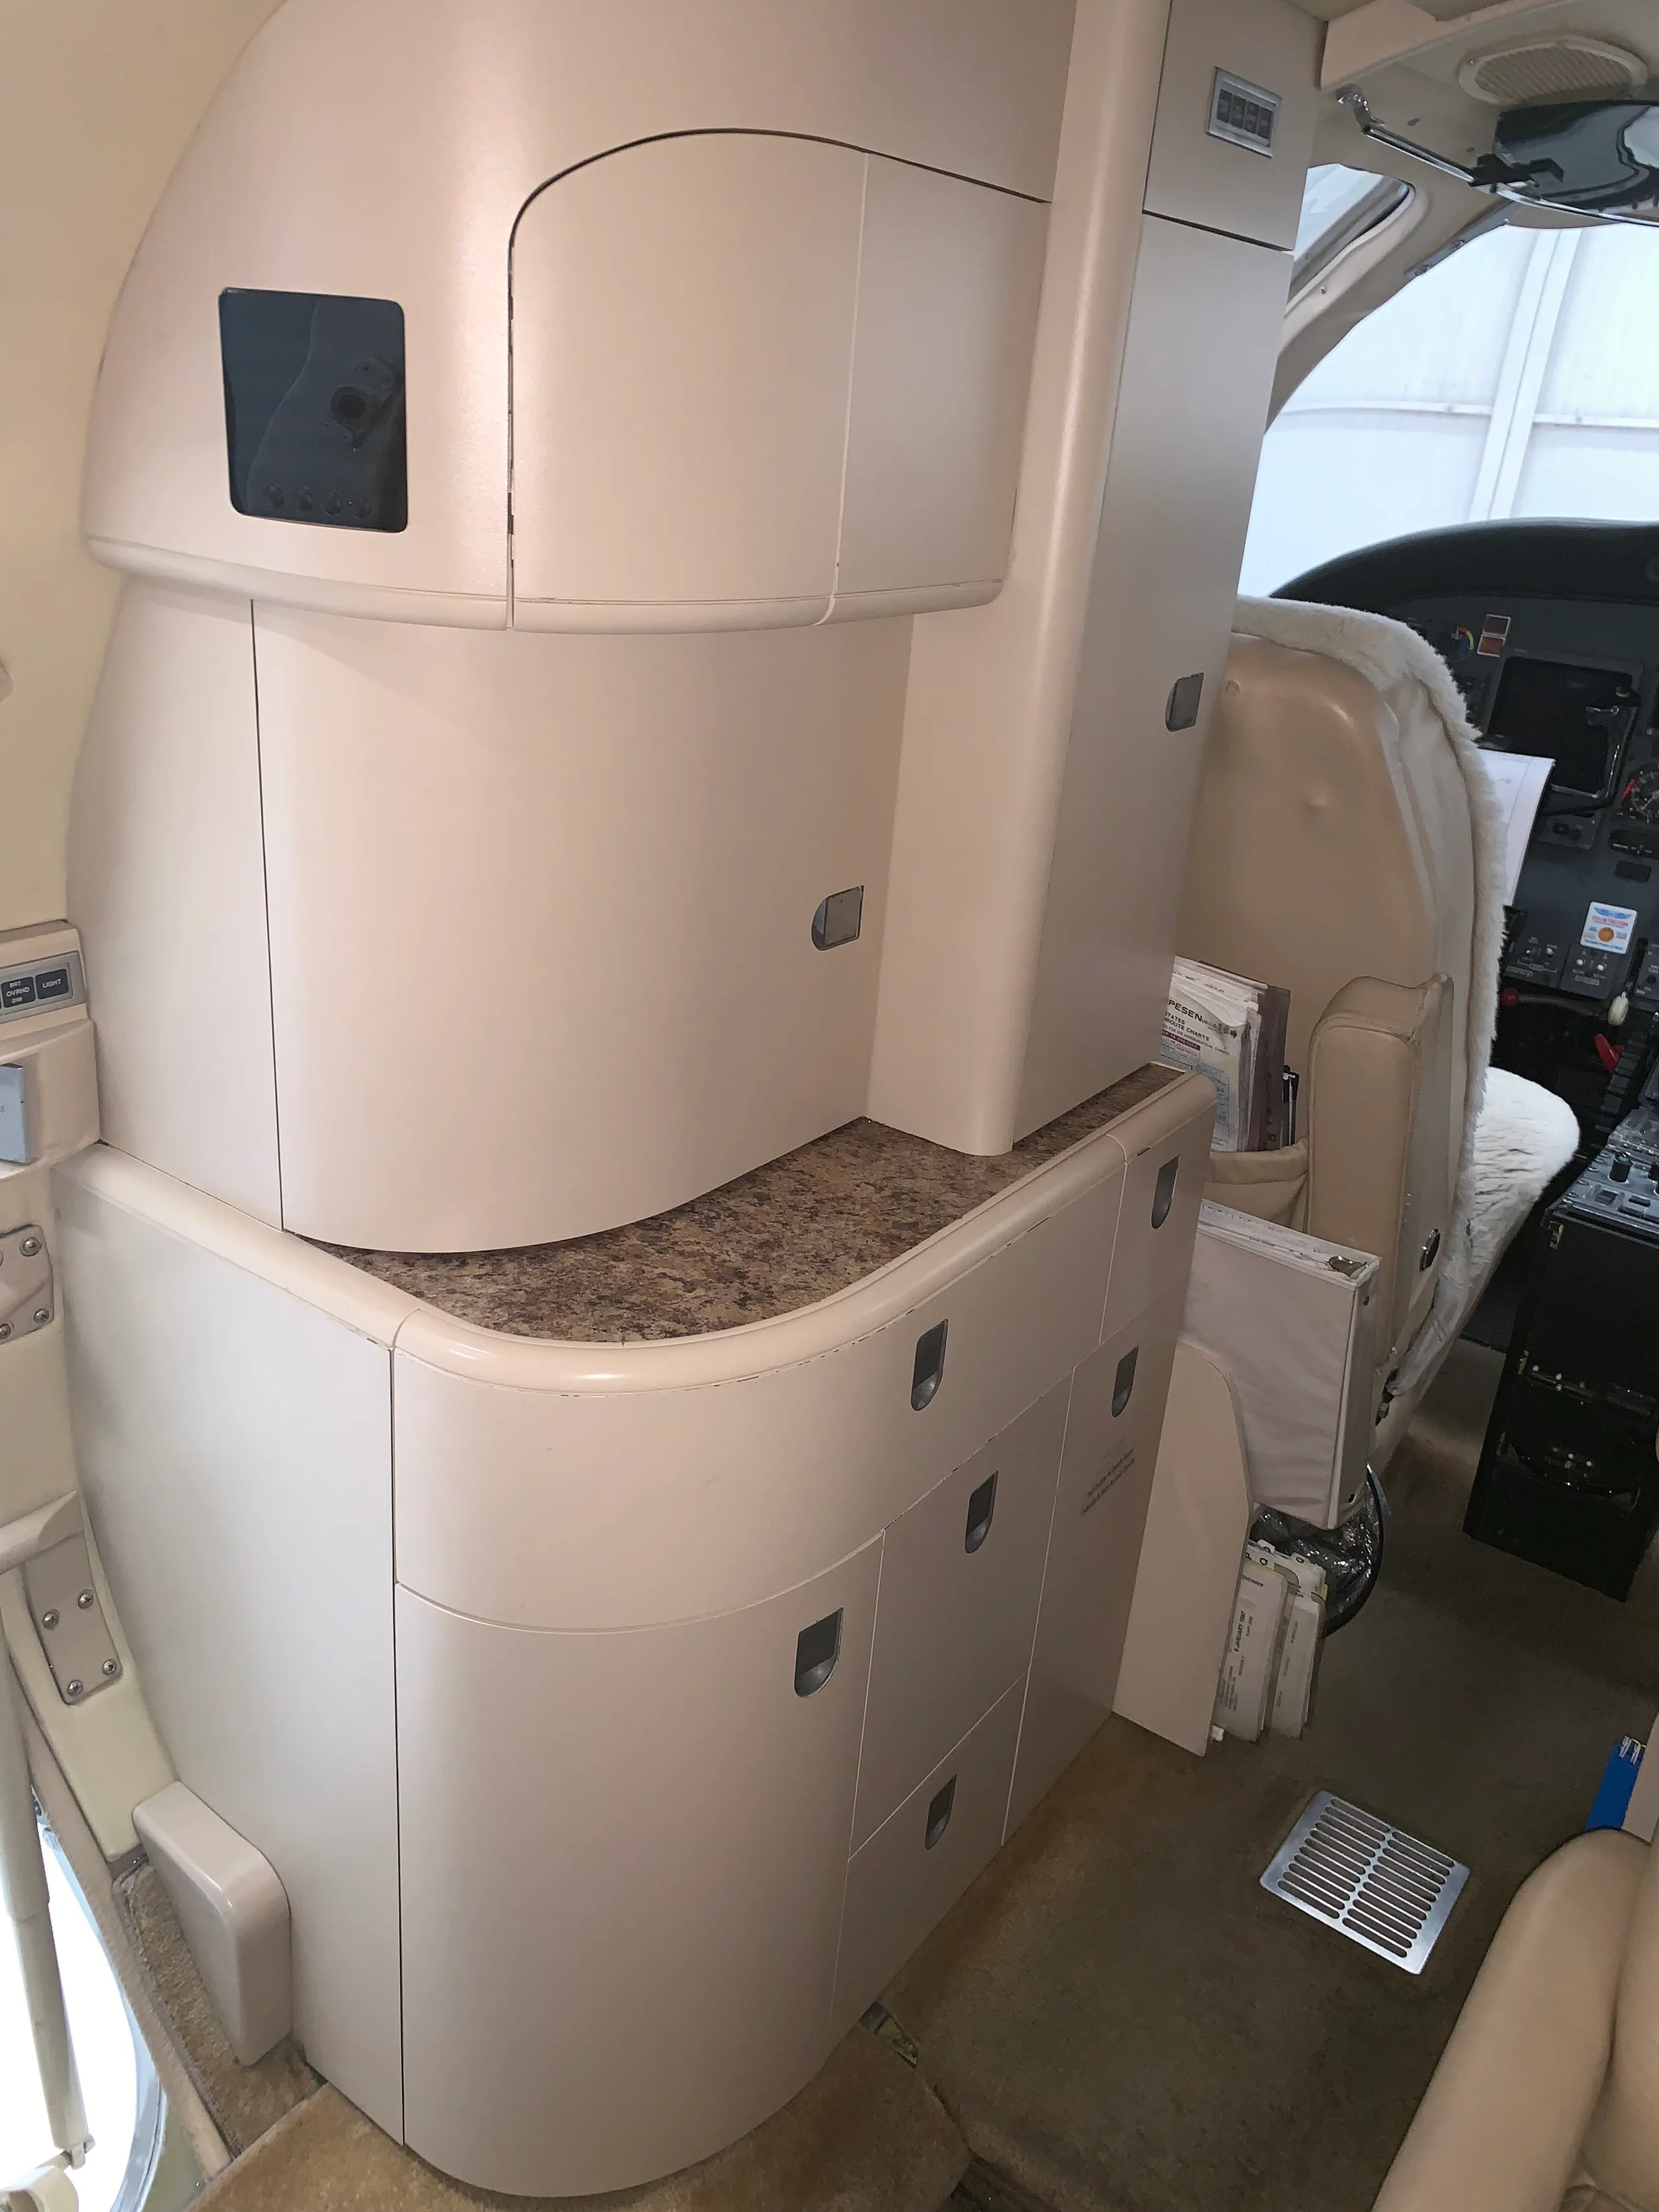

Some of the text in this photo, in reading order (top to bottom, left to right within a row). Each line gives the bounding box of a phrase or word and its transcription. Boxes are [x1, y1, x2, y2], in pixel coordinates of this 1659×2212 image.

[42, 979, 61, 988] LIGHT
[6, 986, 30, 997] OVRHD
[1166, 998, 1202, 1022] PESEN
[1165, 1012, 1185, 1025] TATES
[1186, 1027, 1210, 1042] CHARTS
[1235, 1623, 1244, 1648] JANUARY
